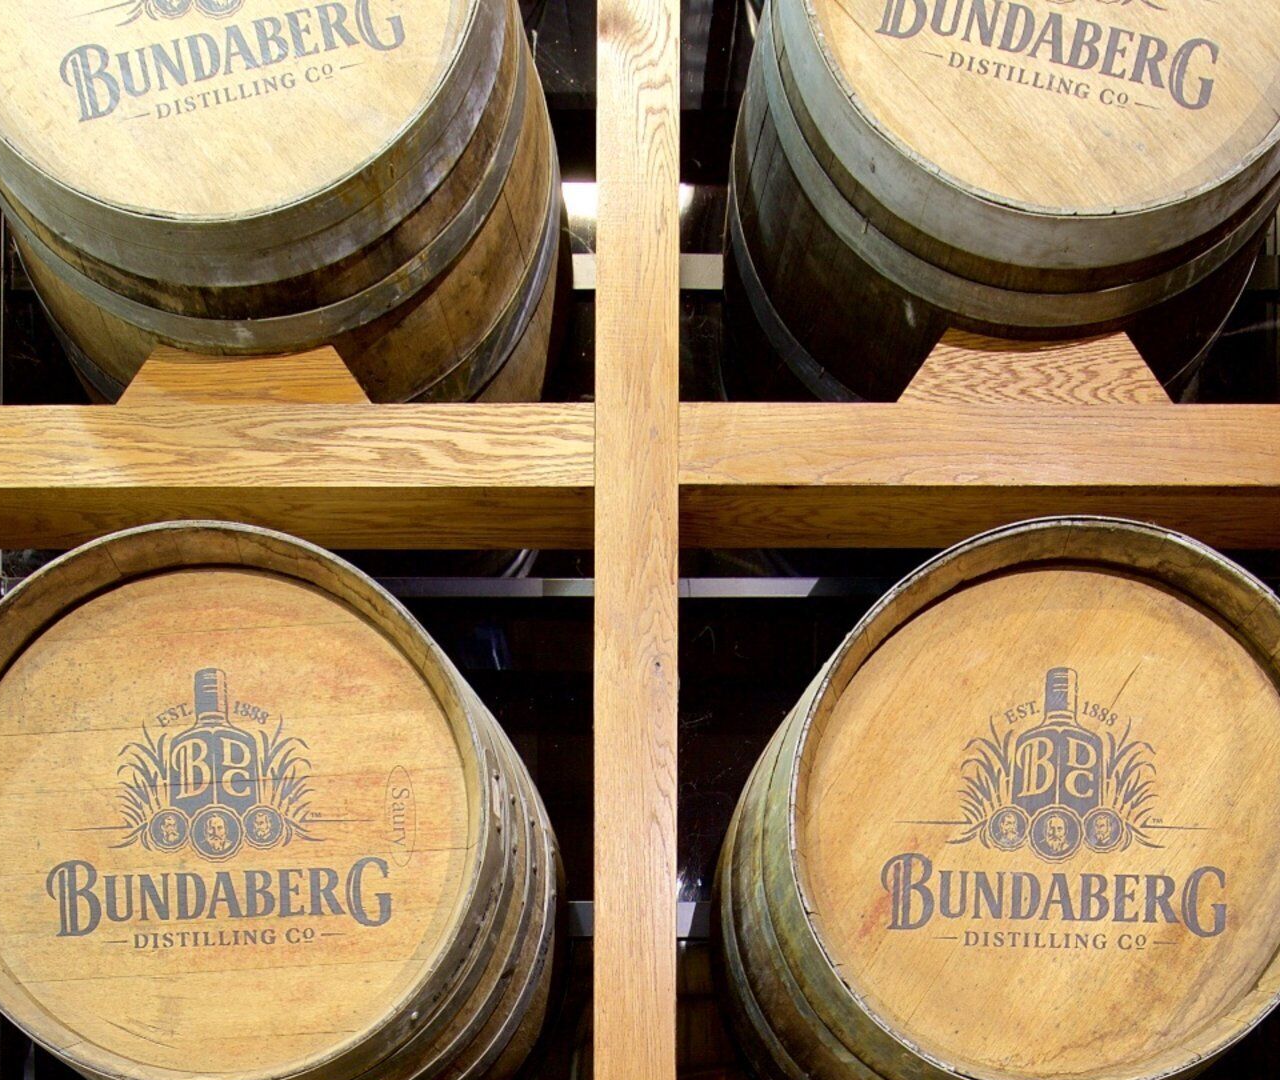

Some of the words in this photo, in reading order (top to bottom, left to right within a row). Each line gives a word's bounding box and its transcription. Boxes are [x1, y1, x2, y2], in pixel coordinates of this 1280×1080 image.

[59, 0, 406, 123] BUNDABERG
[948, 52, 1090, 100] DISTILLING
[157, 72, 296, 121] DISTILLING
[155, 702, 193, 727] EST.
[233, 701, 269, 725] 1888
[1004, 701, 1040, 725] EST.
[1082, 701, 1118, 726] 1888
[390, 786, 410, 847] Saury
[46, 856, 392, 937] BUNDABERG
[881, 852, 1226, 938] BUNDABERG
[134, 929, 277, 949] DISTILLING
[964, 932, 1108, 950] DISTILLING
